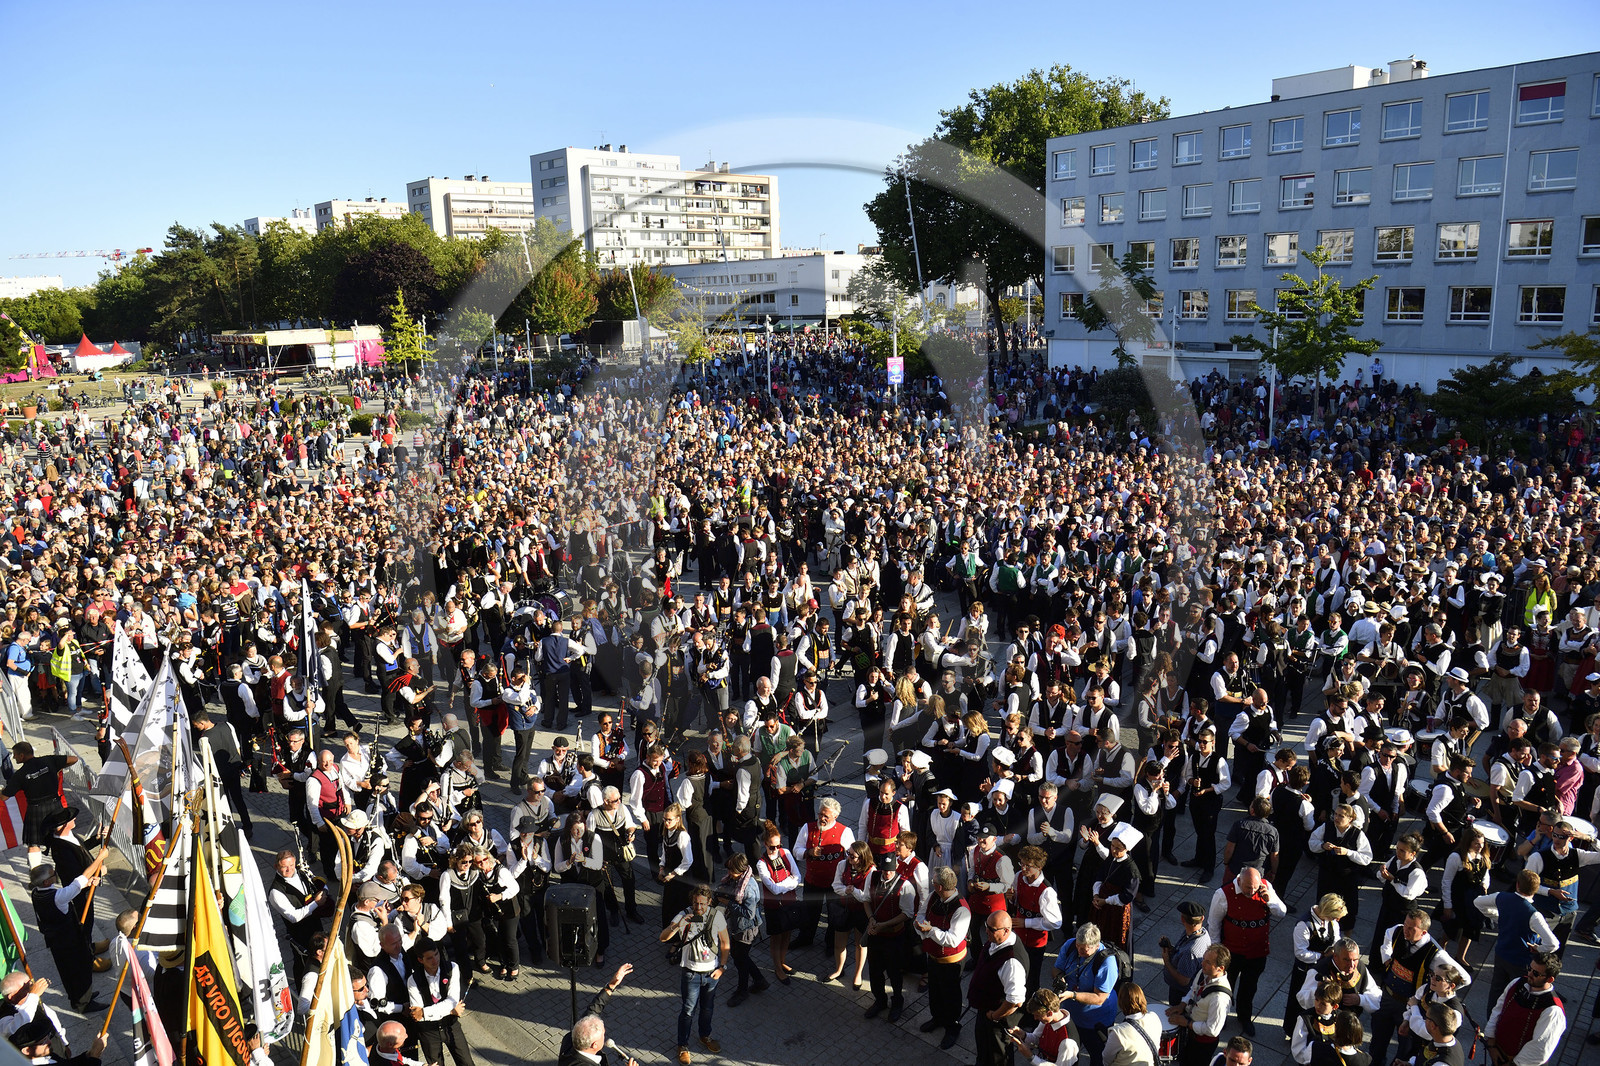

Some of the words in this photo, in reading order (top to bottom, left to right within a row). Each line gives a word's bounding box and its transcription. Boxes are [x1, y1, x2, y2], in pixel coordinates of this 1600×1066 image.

[193, 965, 215, 988] AR
[205, 984, 231, 1020] VRO
[223, 1016, 251, 1066] VIGOU
